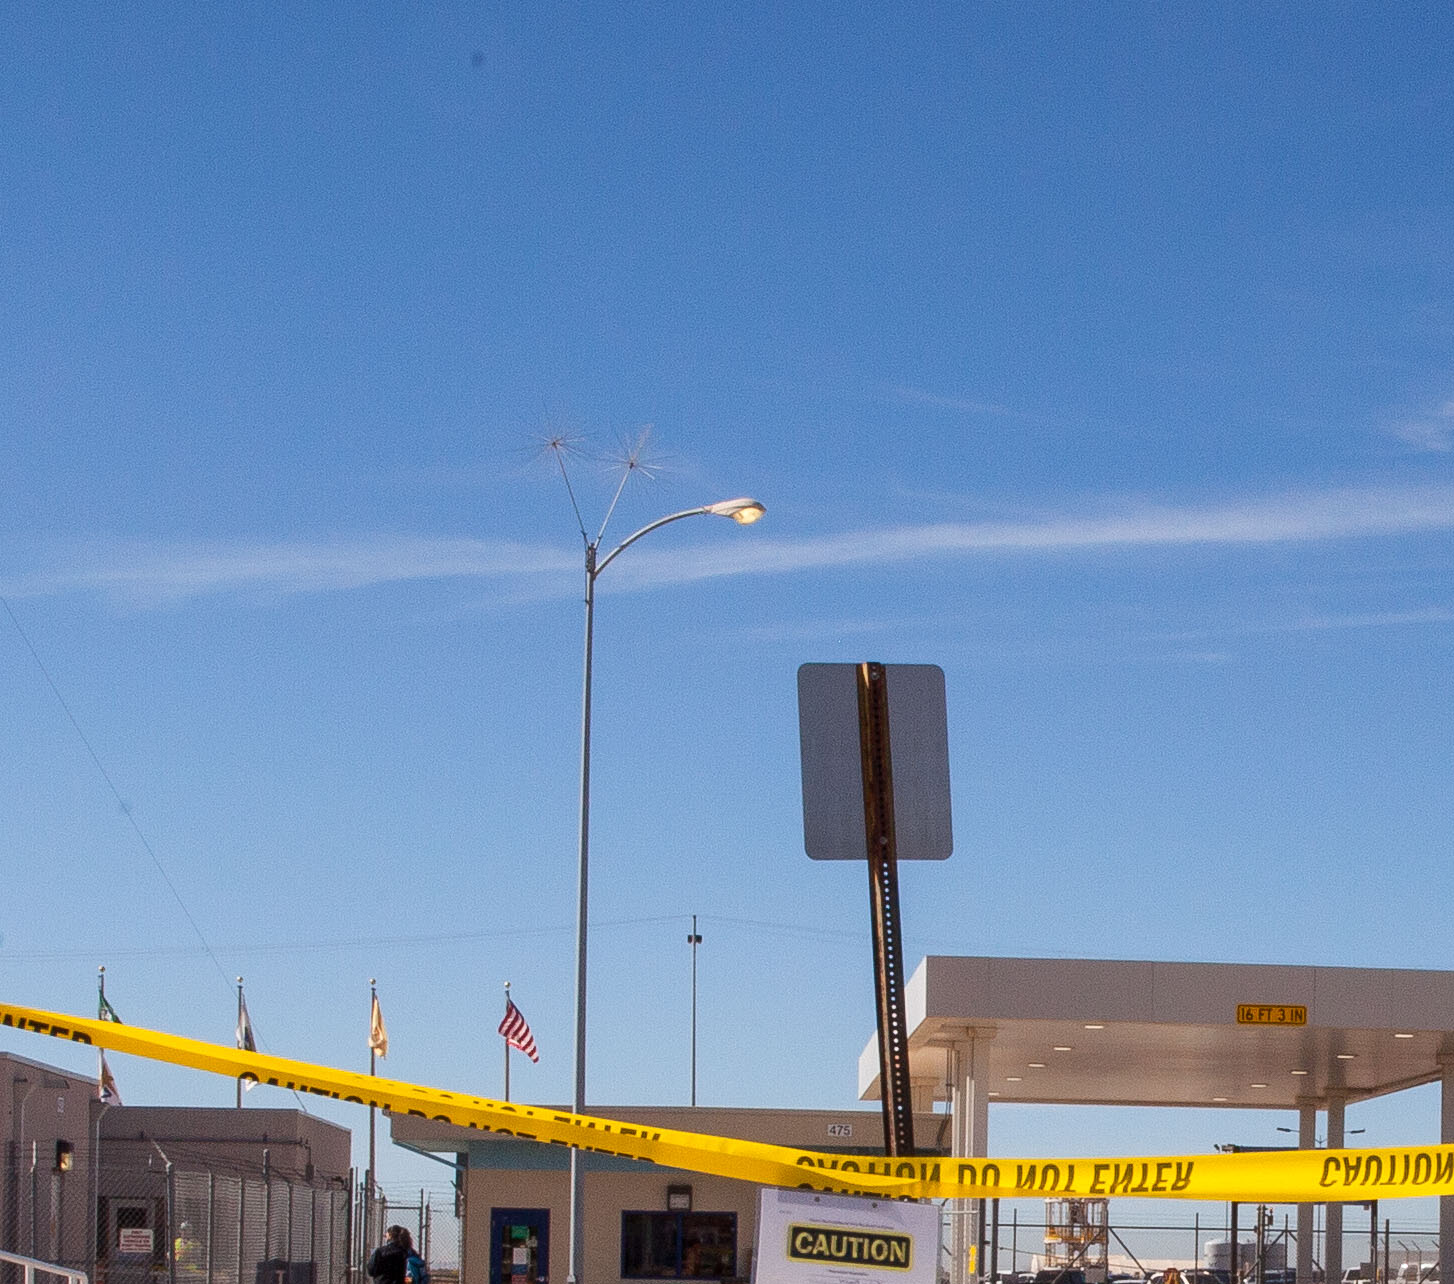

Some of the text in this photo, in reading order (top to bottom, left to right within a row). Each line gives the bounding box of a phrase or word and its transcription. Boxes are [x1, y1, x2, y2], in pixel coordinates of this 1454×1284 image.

[1240, 1007, 1303, 1022] 16 FT 3 IN
[829, 1125, 851, 1136] 475
[795, 1231, 907, 1262] CAUTION
